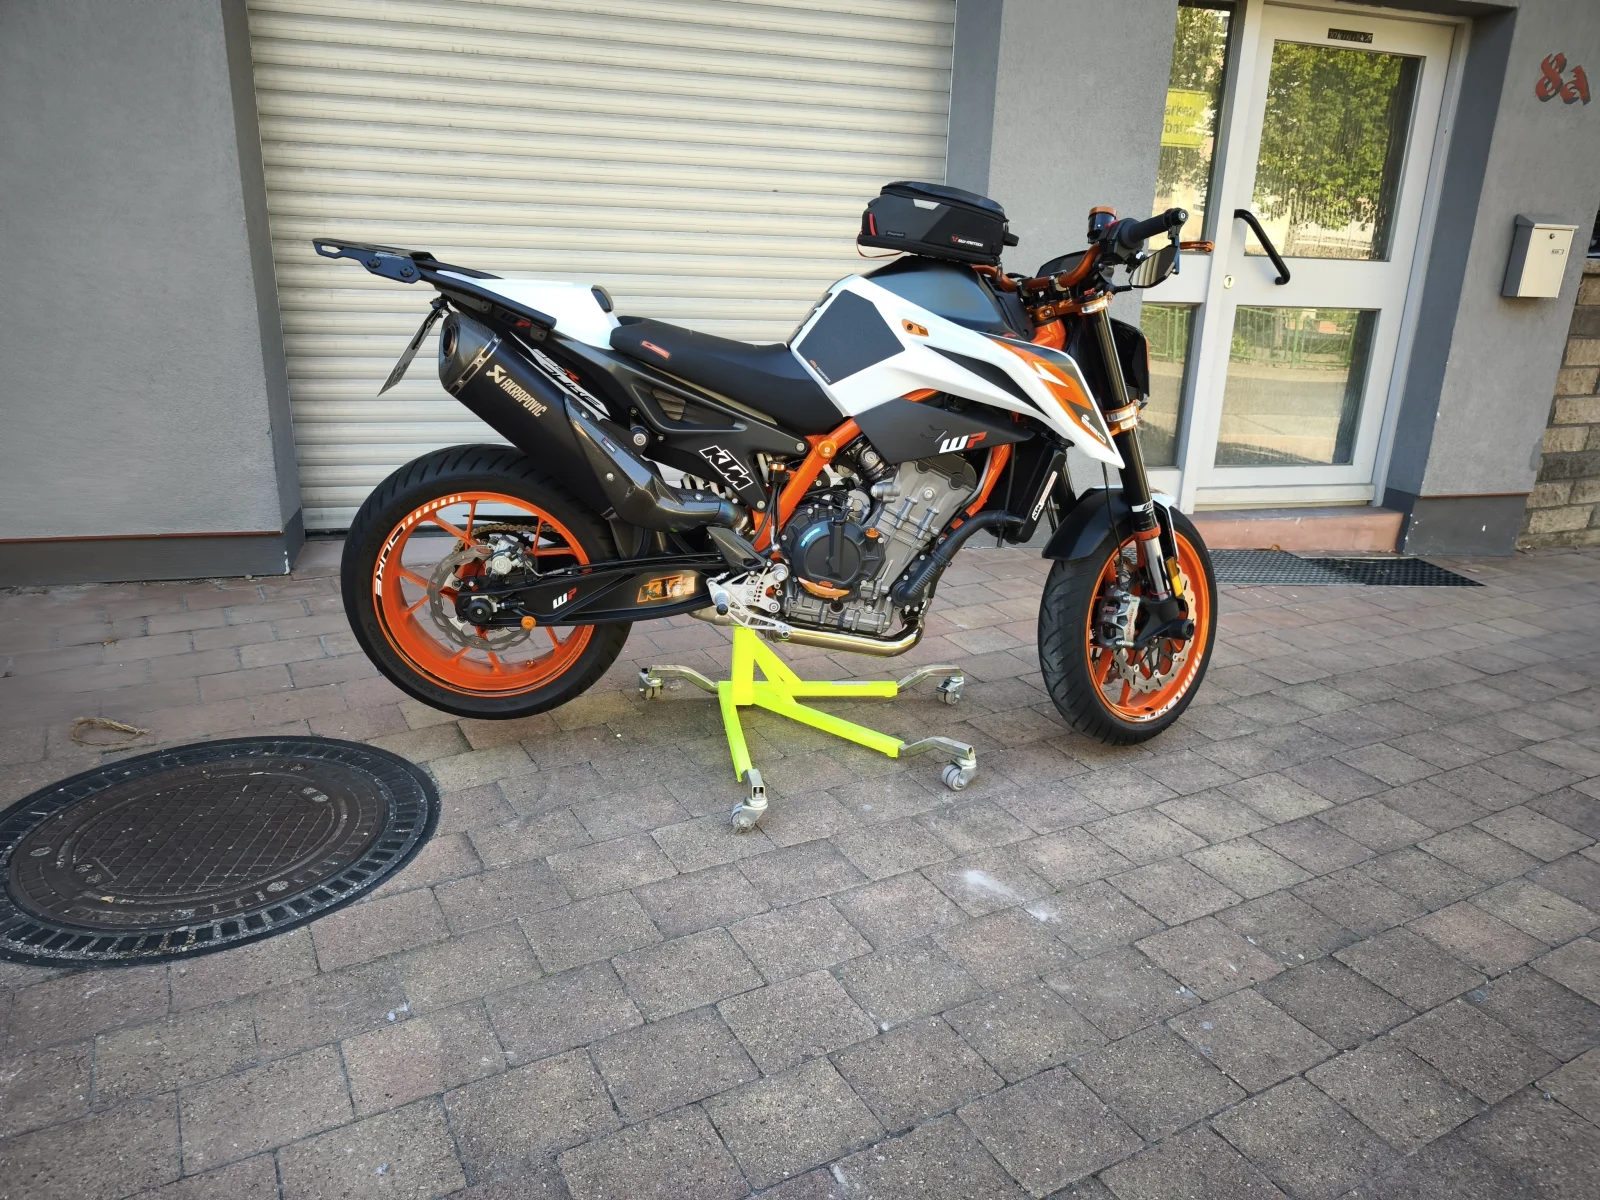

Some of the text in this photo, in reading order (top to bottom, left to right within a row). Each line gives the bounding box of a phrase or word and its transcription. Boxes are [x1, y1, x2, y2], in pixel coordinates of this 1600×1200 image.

[1535, 52, 1591, 105] 8a
[500, 377, 548, 418] AKRAPOVIČ
[938, 431, 988, 454] WP
[699, 445, 754, 491] KTM
[552, 587, 578, 610] WP
